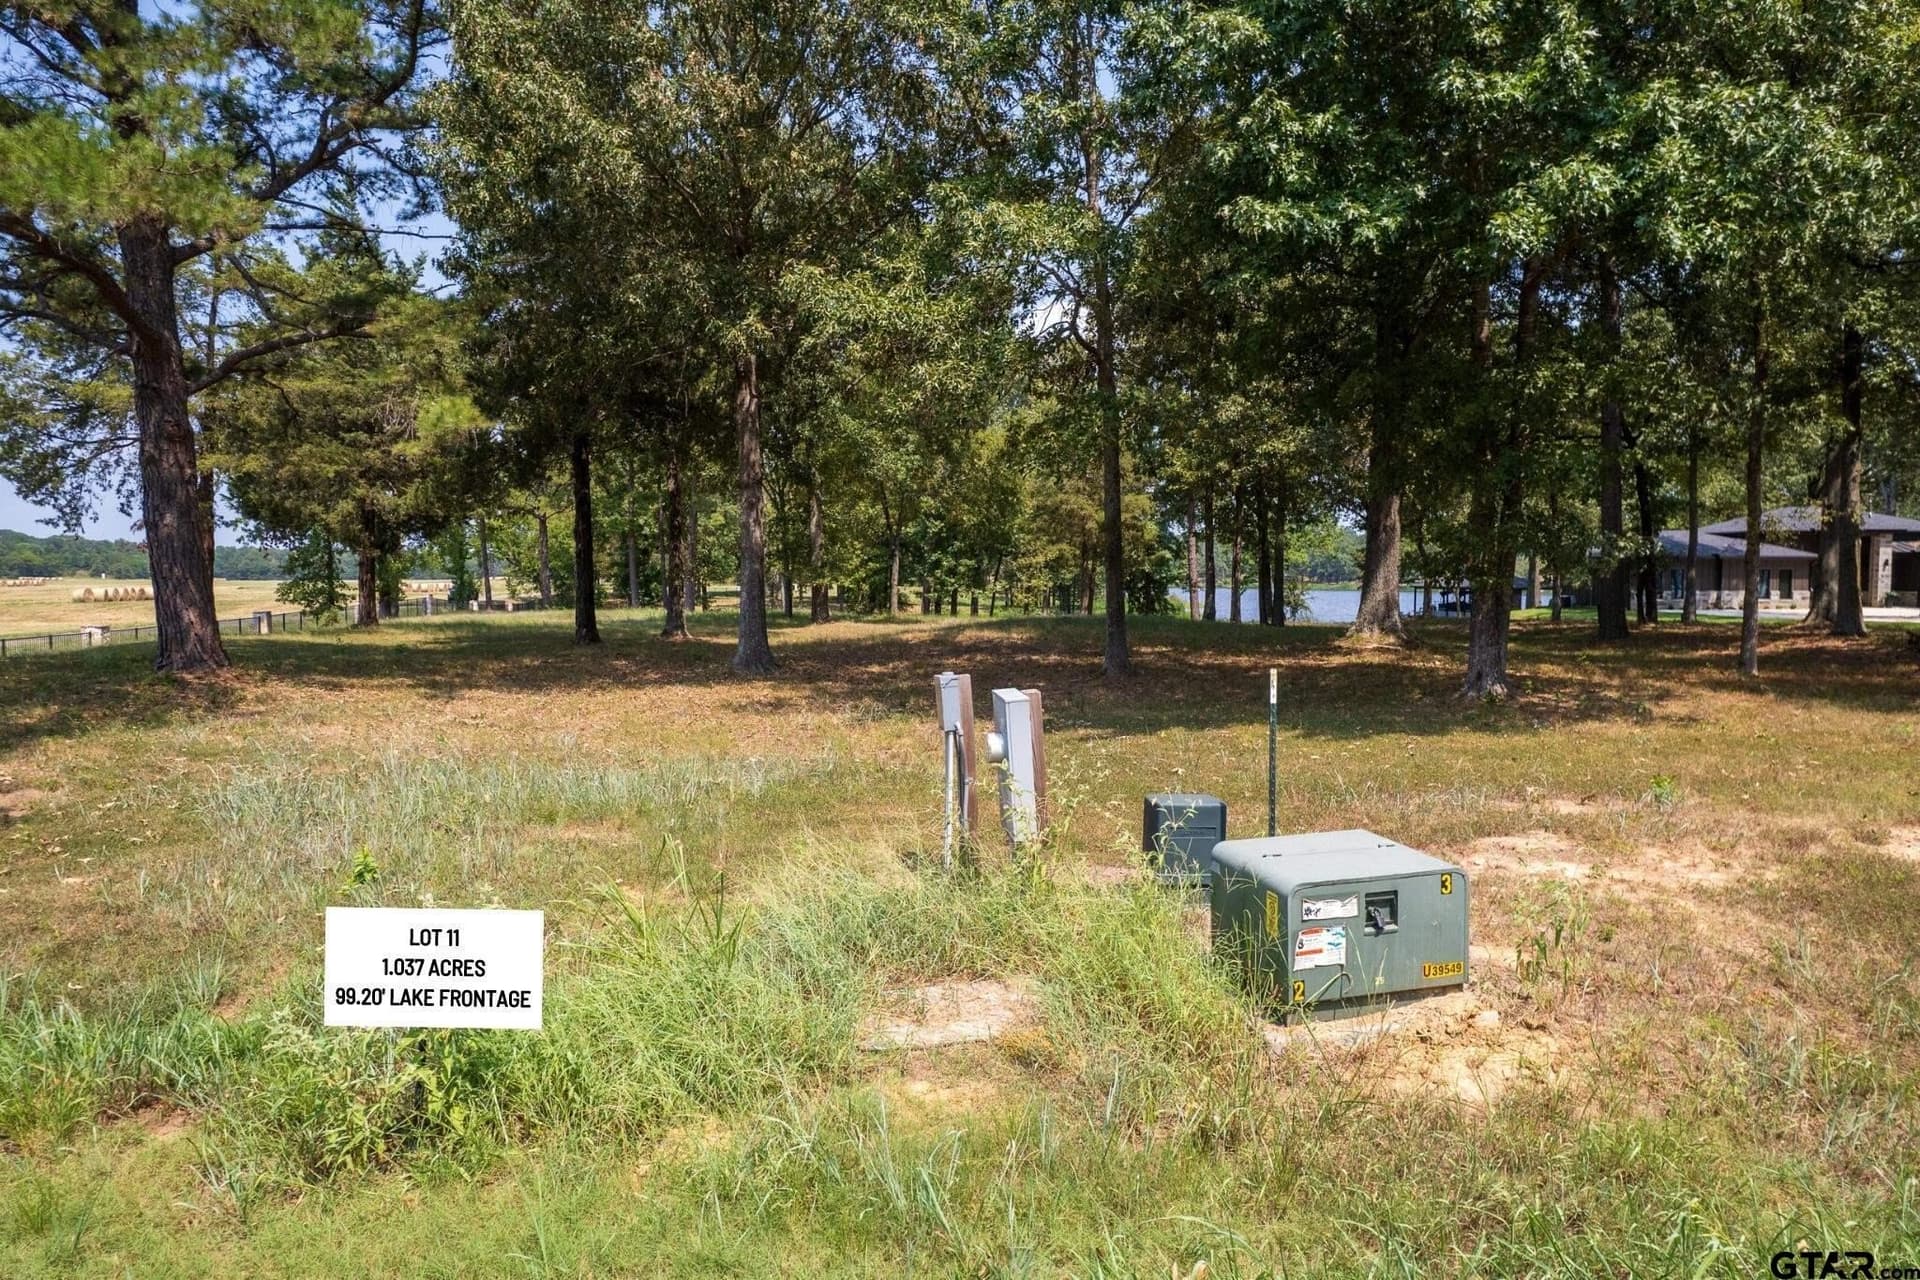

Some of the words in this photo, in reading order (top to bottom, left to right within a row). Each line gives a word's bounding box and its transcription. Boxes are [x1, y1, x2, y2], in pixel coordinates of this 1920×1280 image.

[1441, 874, 1451, 894] 3
[409, 928, 442, 946] LOT
[446, 929, 460, 947] 11
[382, 958, 425, 976] 1.037
[428, 959, 486, 977] ACRES
[1423, 963, 1462, 978] U39549
[335, 987, 385, 1006] 99.20'
[390, 988, 434, 1007] LAKE
[440, 989, 531, 1008] FRONTAGE
[1295, 982, 1304, 1000] 2
